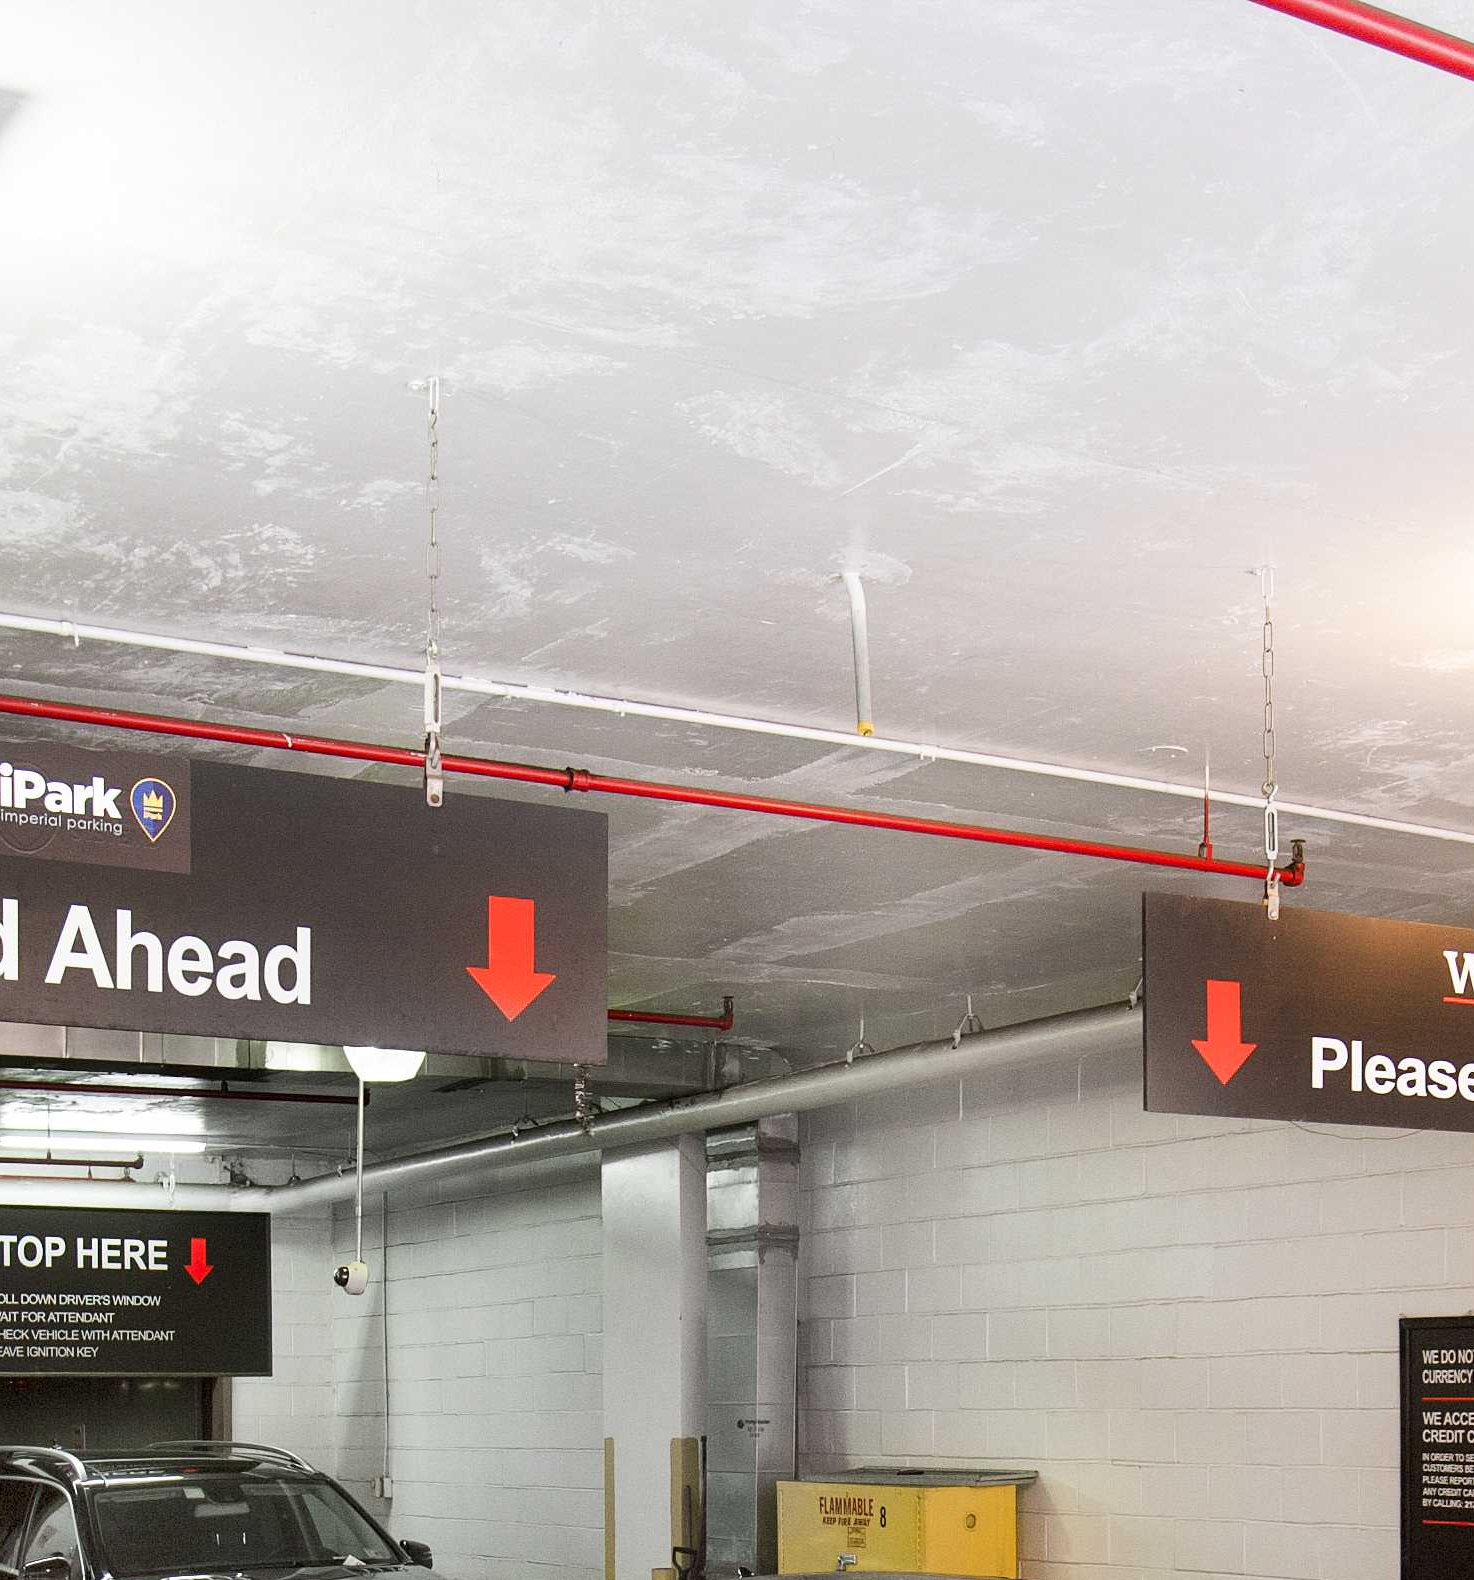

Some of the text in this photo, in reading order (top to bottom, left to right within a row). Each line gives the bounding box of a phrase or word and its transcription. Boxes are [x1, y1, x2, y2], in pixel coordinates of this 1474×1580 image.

[0, 763, 123, 819] iPark
[0, 809, 123, 837] imperial parking
[45, 904, 311, 1005] Ahead
[77, 1237, 168, 1270] HERE
[21, 1294, 57, 1305] DOWN
[59, 1294, 111, 1305] DRIVER'S
[112, 1296, 160, 1306] WINDOW
[22, 1312, 46, 1322] FOR
[48, 1312, 115, 1323] ATTENDANT
[31, 1330, 79, 1340] VEHICLE
[81, 1330, 110, 1341] WITH
[112, 1330, 175, 1341] ATTENDANT
[27, 1347, 74, 1357] IGNITION
[77, 1347, 99, 1358] KEY
[1422, 1350, 1439, 1364] WE
[1441, 1350, 1456, 1364] DO
[1422, 1369, 1473, 1384] CURRENCY
[1422, 1412, 1441, 1425] WE
[1422, 1429, 1465, 1443] CREDIT
[819, 1497, 874, 1517] FLAMMABLE
[823, 1517, 870, 1526] KEEP FIRE AWAY
[880, 1506, 887, 1527] 8
